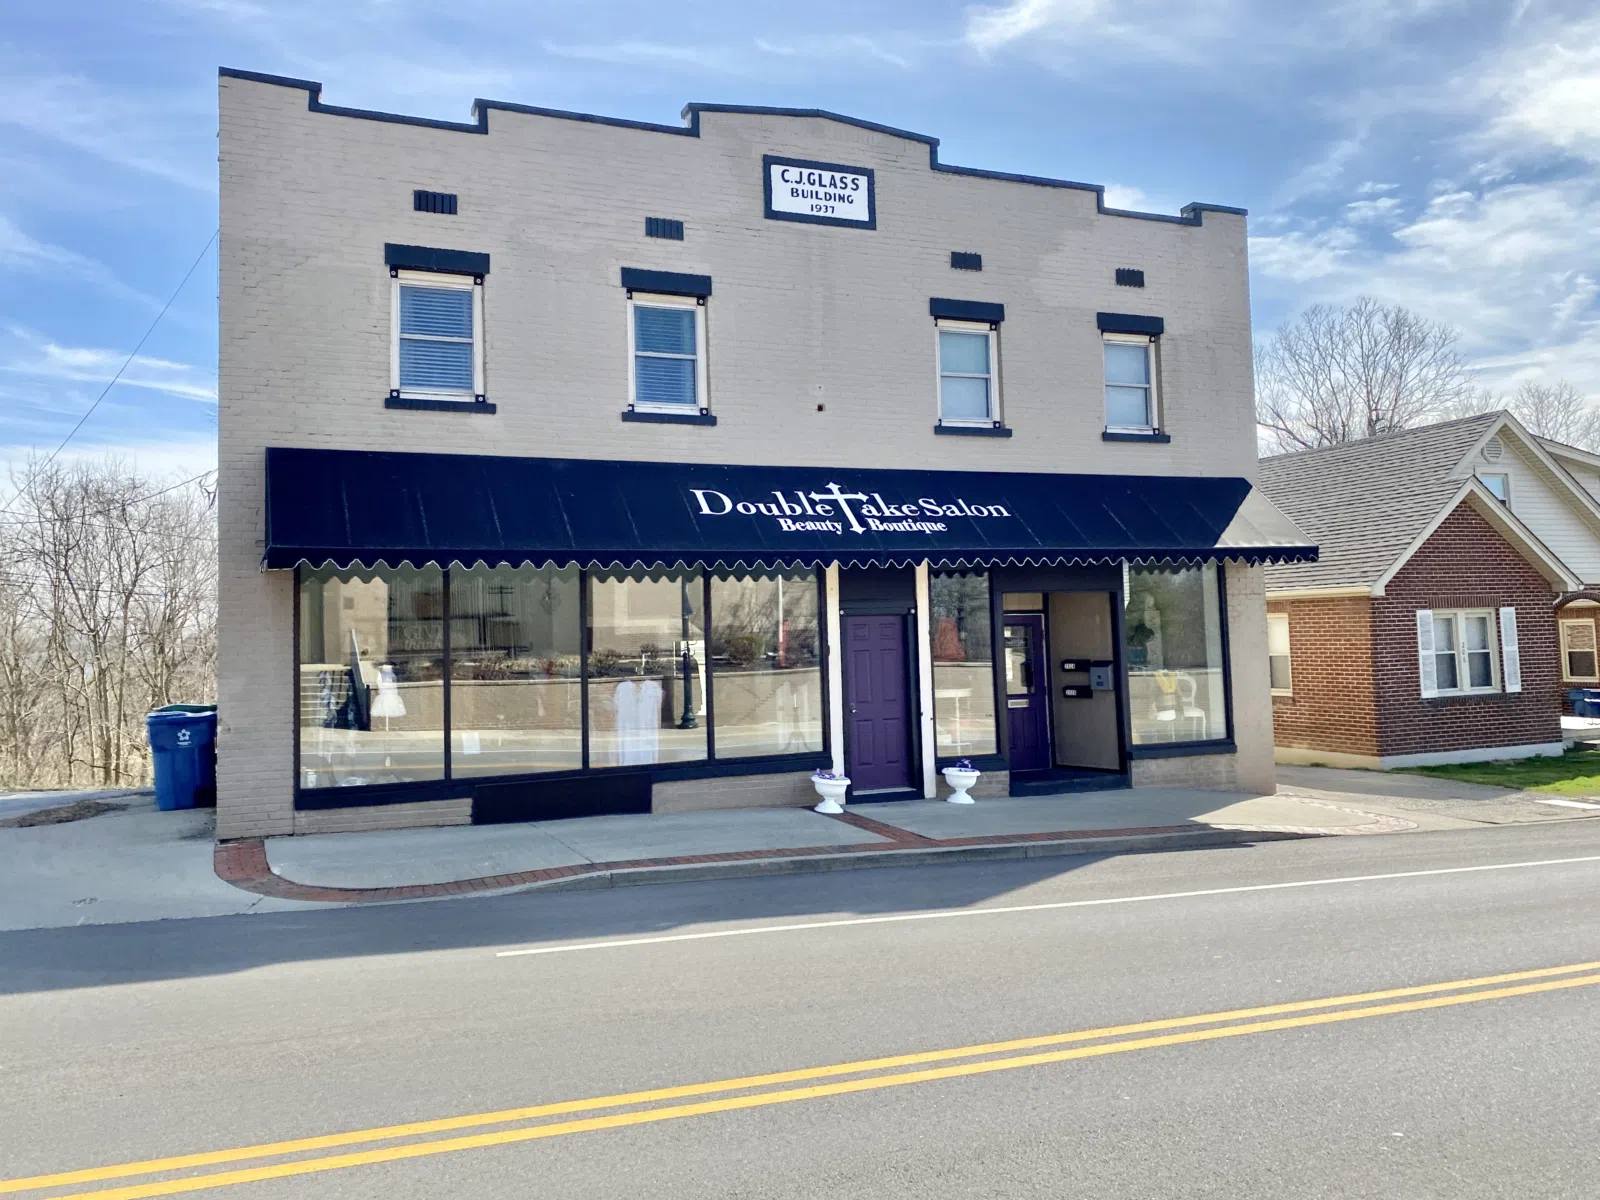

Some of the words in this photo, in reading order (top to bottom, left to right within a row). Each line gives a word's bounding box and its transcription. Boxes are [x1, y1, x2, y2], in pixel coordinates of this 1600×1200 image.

[790, 187, 854, 205] BUILDING
[810, 204, 836, 214] 1937
[776, 518, 843, 535] Beauty
[865, 517, 948, 535] Boutique
